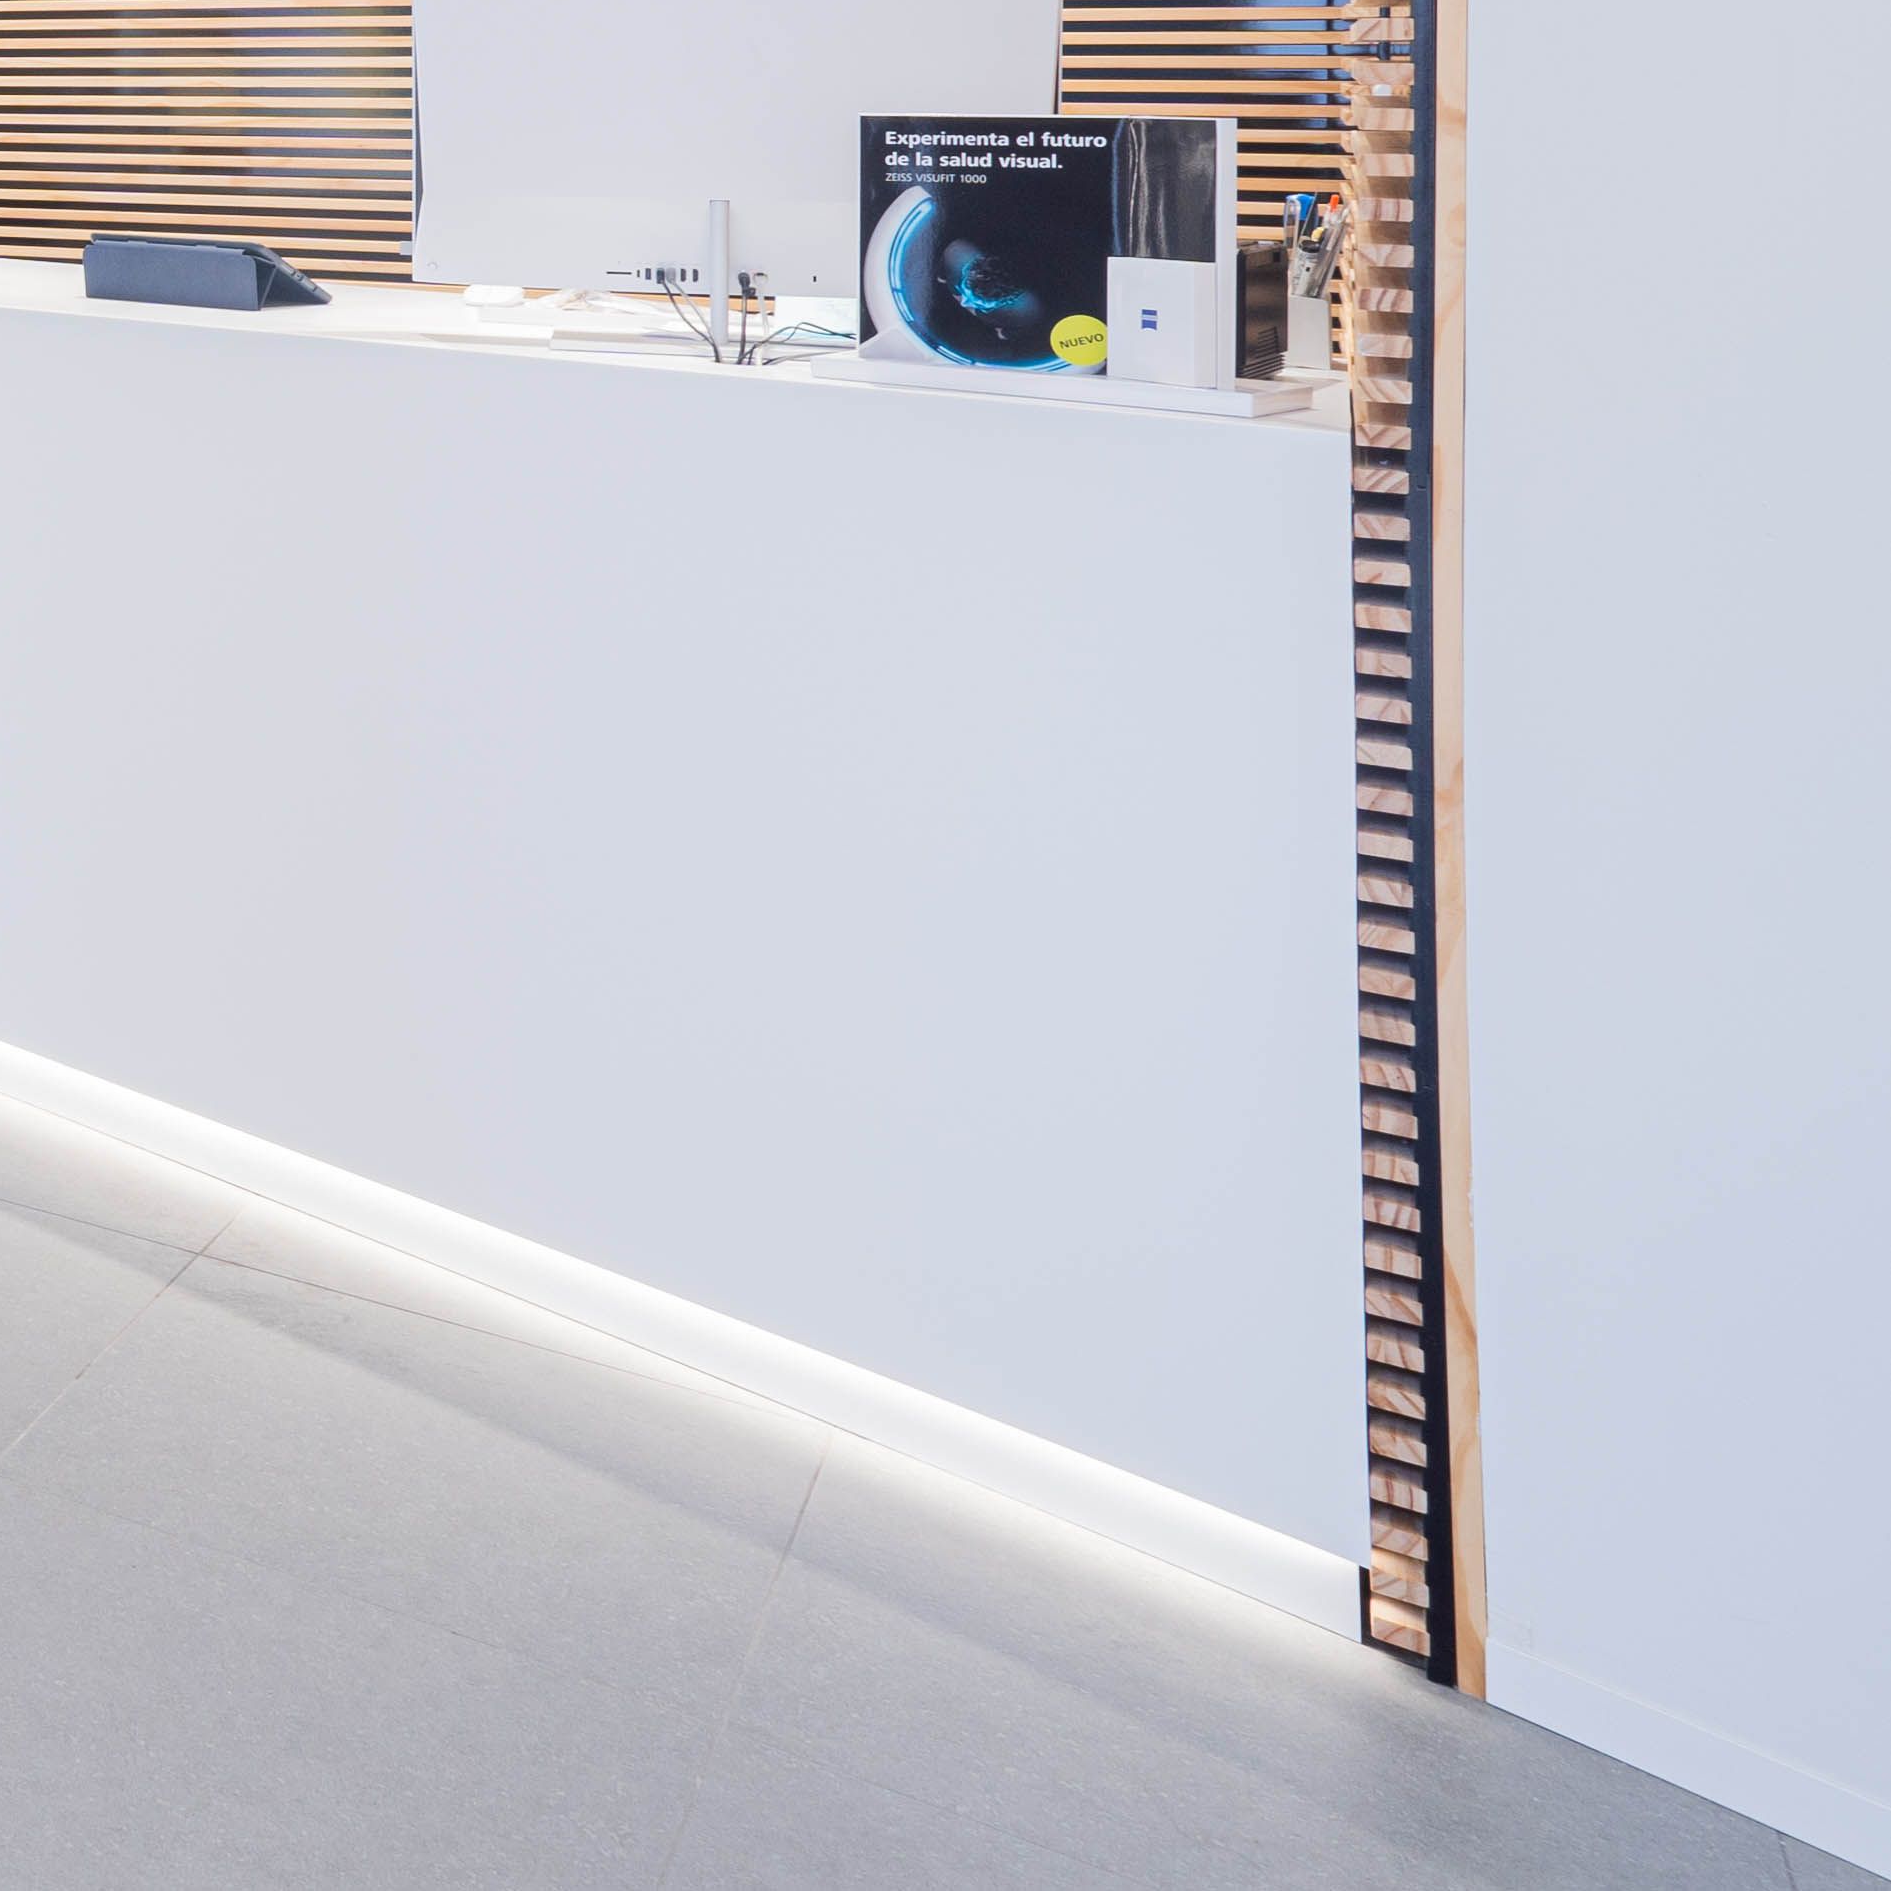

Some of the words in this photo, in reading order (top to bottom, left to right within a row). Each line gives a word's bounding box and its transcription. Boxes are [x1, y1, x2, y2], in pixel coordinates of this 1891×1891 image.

[885, 130, 1010, 149] Experimenta
[1016, 131, 1035, 147] el
[1041, 131, 1108, 148] futuro
[885, 151, 910, 167] de
[915, 151, 933, 167] la
[938, 152, 992, 168] salud
[998, 153, 1064, 169] visual.
[885, 172, 912, 183] ZEISS
[916, 173, 955, 184] VISUFIT
[960, 174, 987, 185] 1000
[1058, 332, 1105, 350] NUEVO
